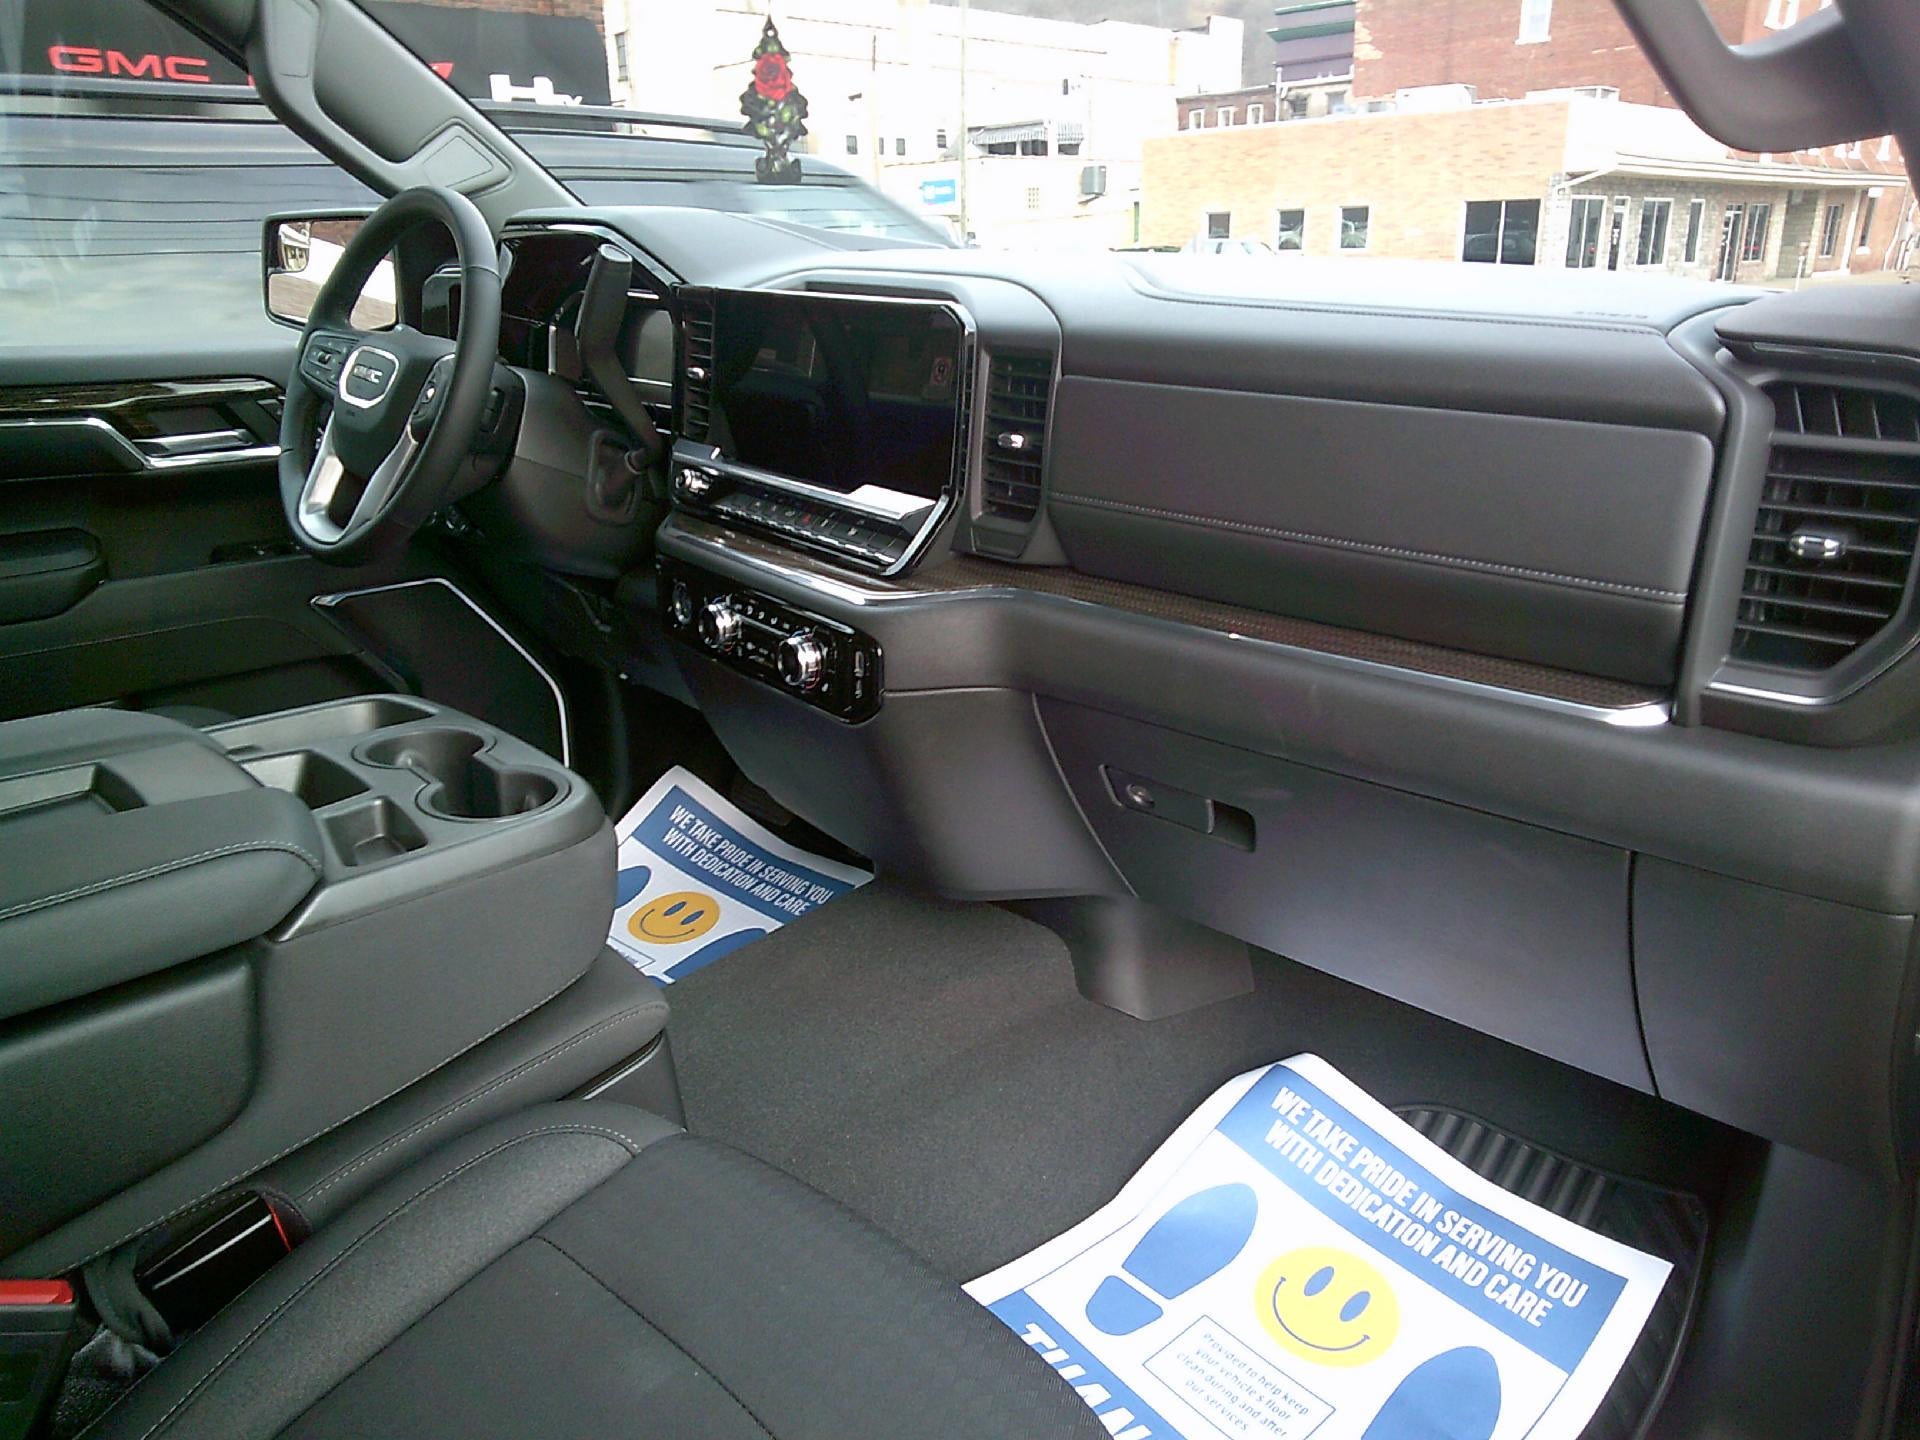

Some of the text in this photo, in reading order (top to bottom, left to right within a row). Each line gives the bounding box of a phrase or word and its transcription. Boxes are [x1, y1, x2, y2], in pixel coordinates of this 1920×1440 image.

[48, 45, 211, 82] GMC
[662, 828, 811, 916] WITH DEDICATION AND CARE
[669, 804, 834, 904] WE TAKE PRIDE IN SERVING YOU
[1264, 1119, 1553, 1328] WITH DEDICATION AND CARE
[1271, 1086, 1589, 1308] WE TAKE PRIDE IN SERVING YOU
[1176, 1352, 1288, 1437] clean during and after
[1185, 1378, 1249, 1431] our services
[1195, 1348, 1293, 1420] your vehicles floor
[1203, 1332, 1309, 1415] Provided to help keep
